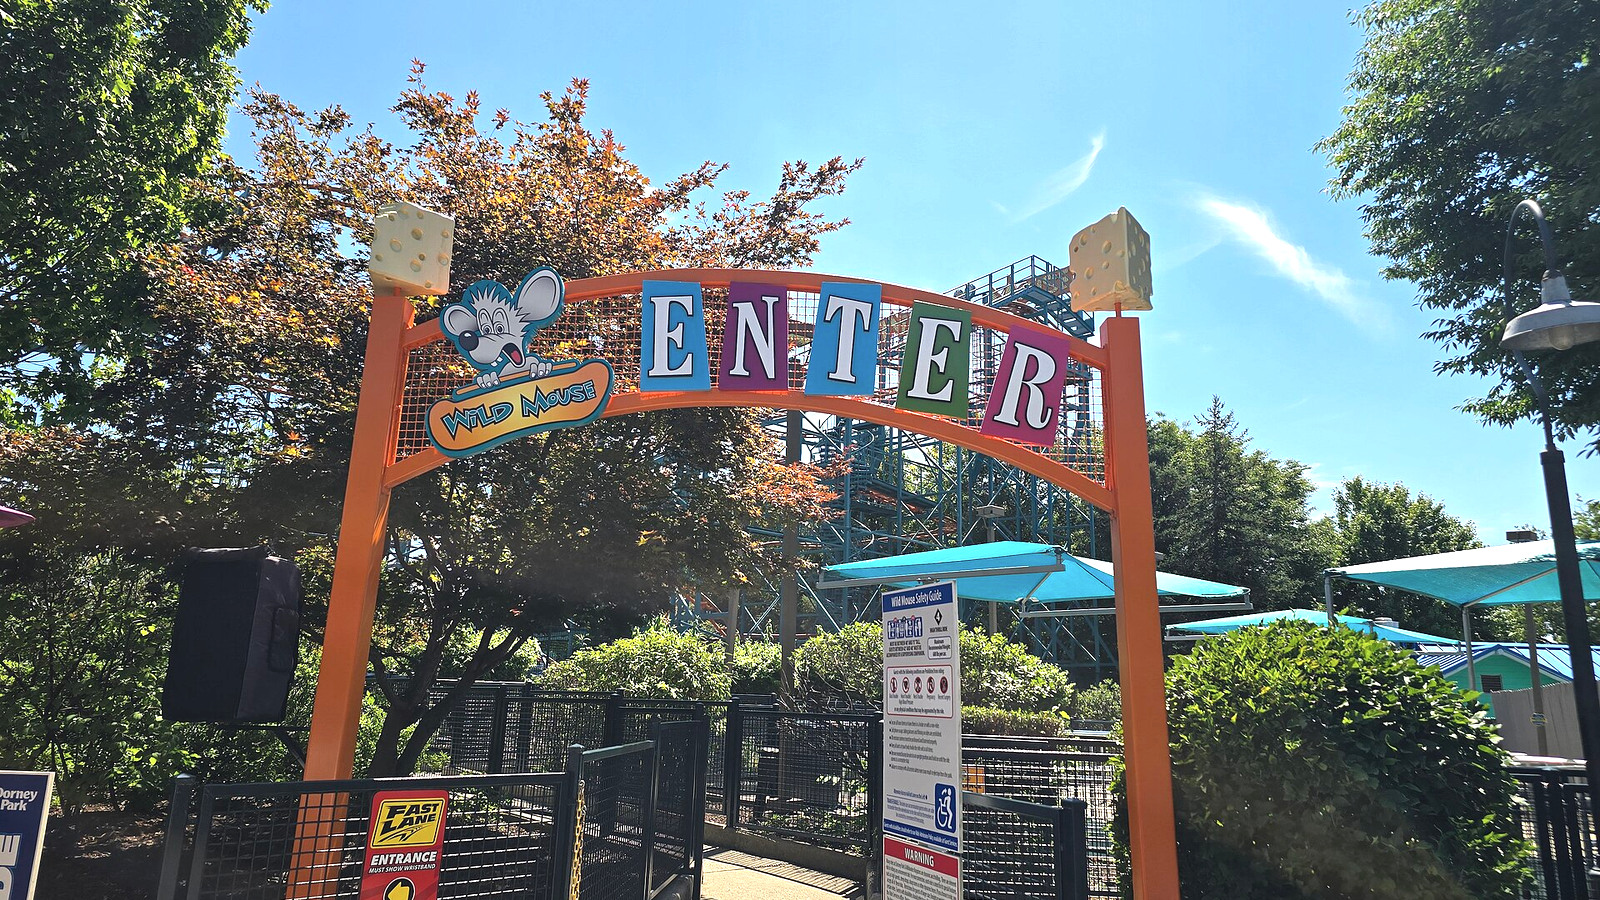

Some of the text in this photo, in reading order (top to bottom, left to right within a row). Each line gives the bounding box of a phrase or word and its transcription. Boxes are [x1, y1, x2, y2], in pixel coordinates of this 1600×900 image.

[647, 294, 1055, 431] ENTER
[891, 588, 942, 608] Wild Mouse Safety Guide
[1, 799, 27, 811] Park
[386, 803, 439, 819] FAST
[380, 813, 436, 836] LANE
[370, 851, 437, 866] ENTRANCE
[905, 847, 934, 867] WARNING
